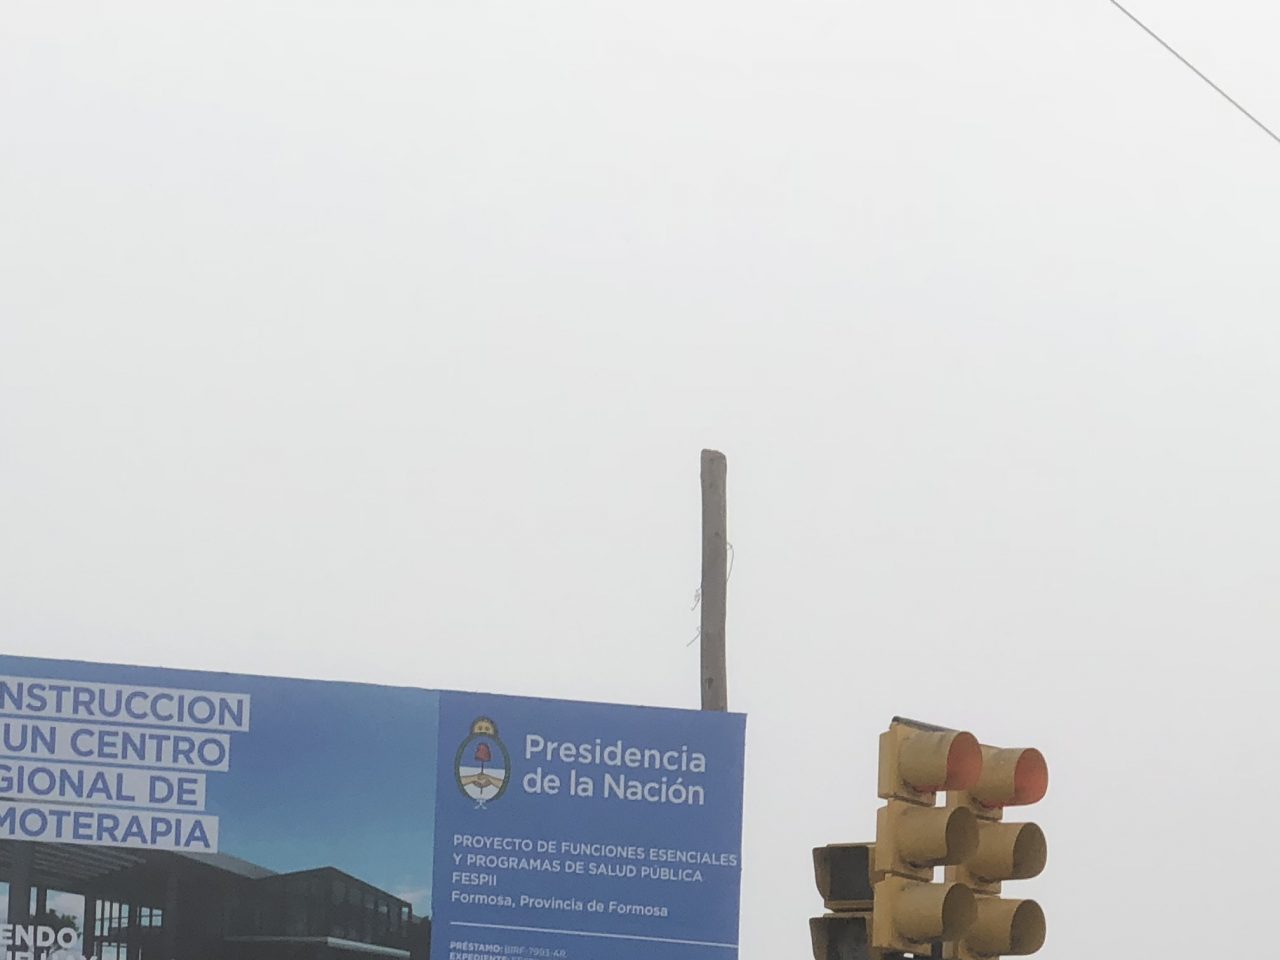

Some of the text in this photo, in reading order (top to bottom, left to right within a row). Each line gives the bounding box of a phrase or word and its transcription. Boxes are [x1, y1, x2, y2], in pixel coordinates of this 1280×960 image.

[3, 723, 57, 754] UN
[70, 728, 226, 766] CENTRO
[524, 734, 706, 773] Presidencia
[149, 775, 198, 806] DE
[522, 767, 705, 805] de la Nación
[453, 834, 737, 866] PROYECTO DE FUNCIONES ESENCIALES
[452, 872, 497, 886] FESPII
[453, 853, 703, 882] Y PROGRAMAS DE SALUD PÚBLICA
[451, 890, 668, 917] Formosa, Provincia de Formosa
